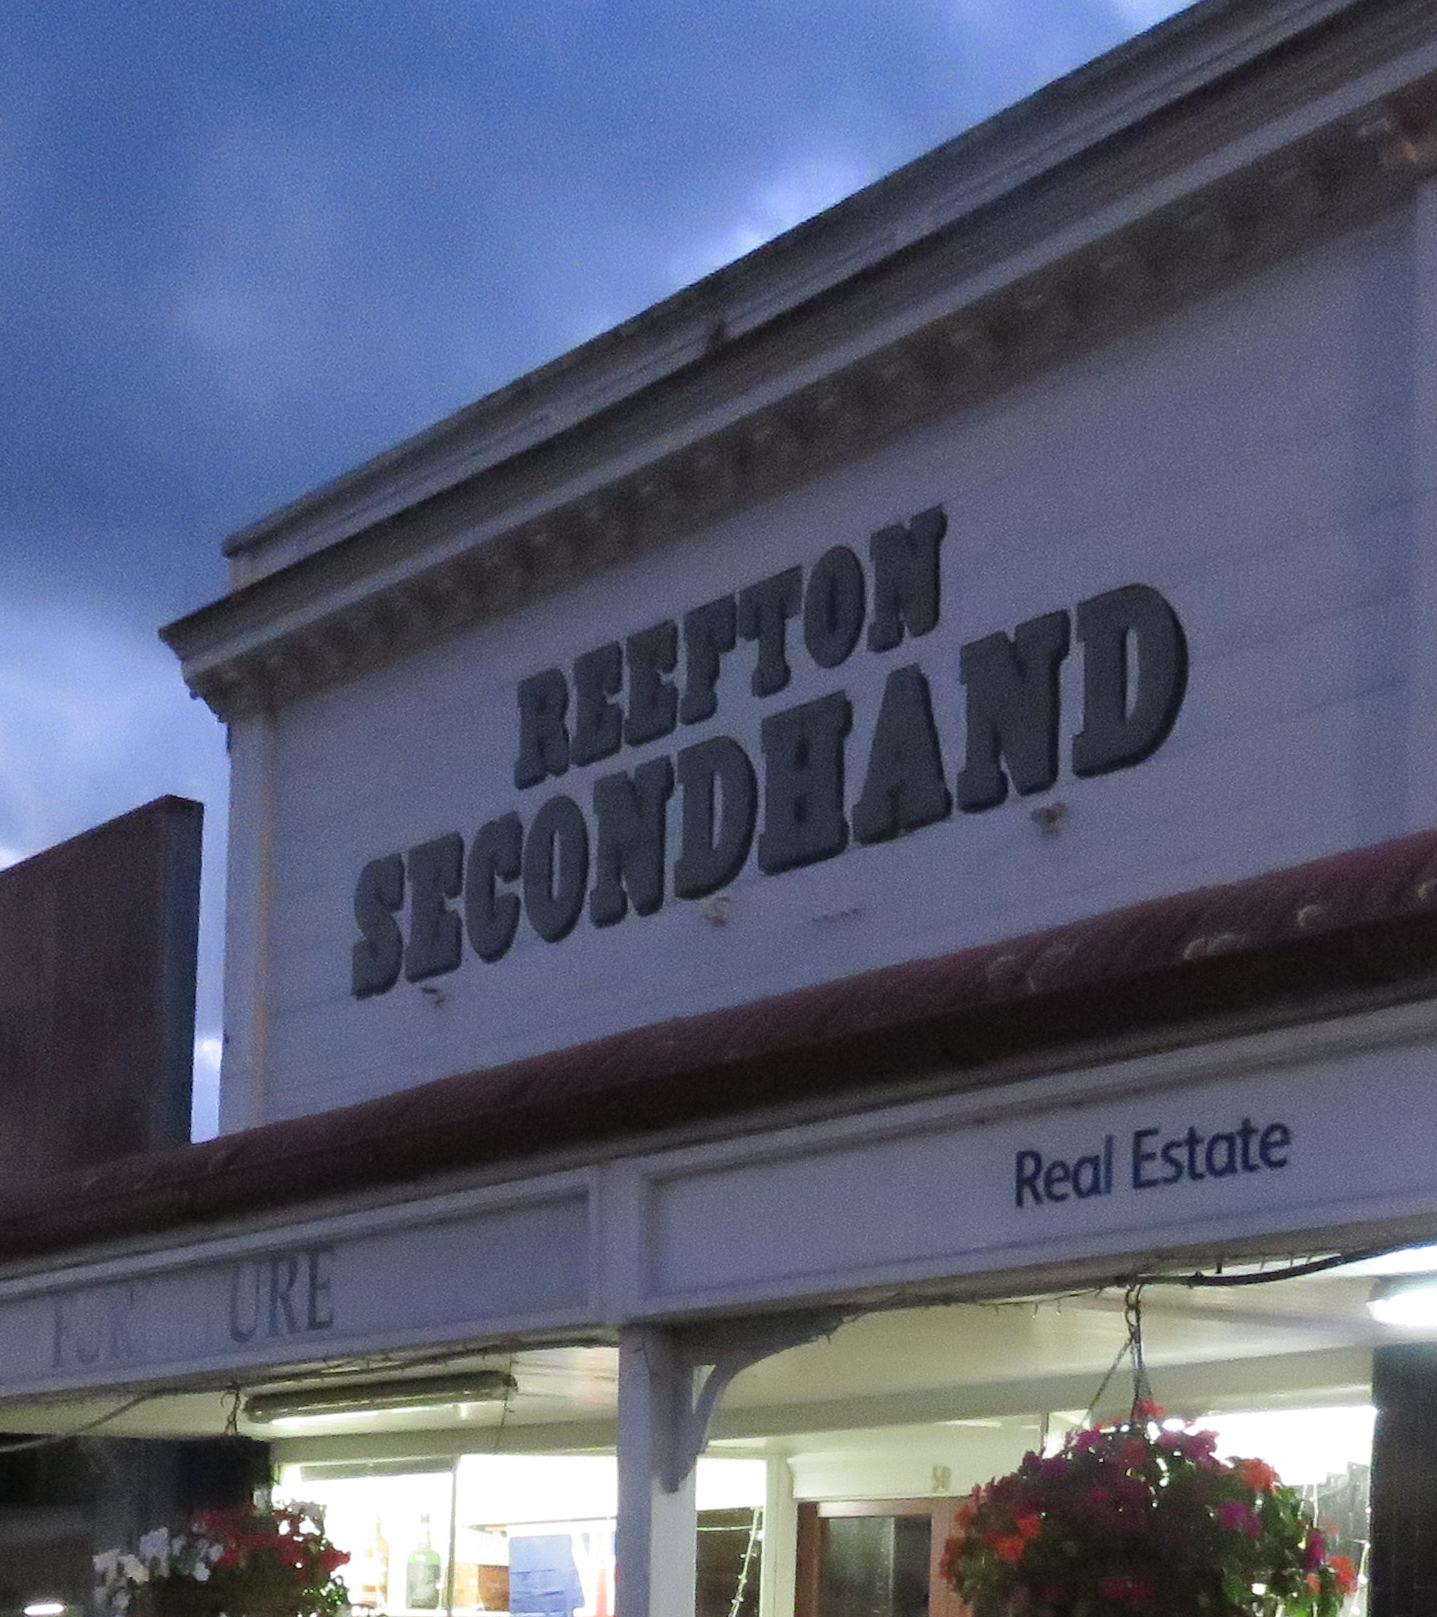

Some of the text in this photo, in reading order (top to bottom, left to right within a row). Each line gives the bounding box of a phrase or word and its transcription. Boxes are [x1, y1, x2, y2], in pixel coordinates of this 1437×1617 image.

[513, 503, 949, 790] REEFTON
[352, 583, 1190, 1000] SECONDHAND
[1016, 1117, 1292, 1207] Real Estate
